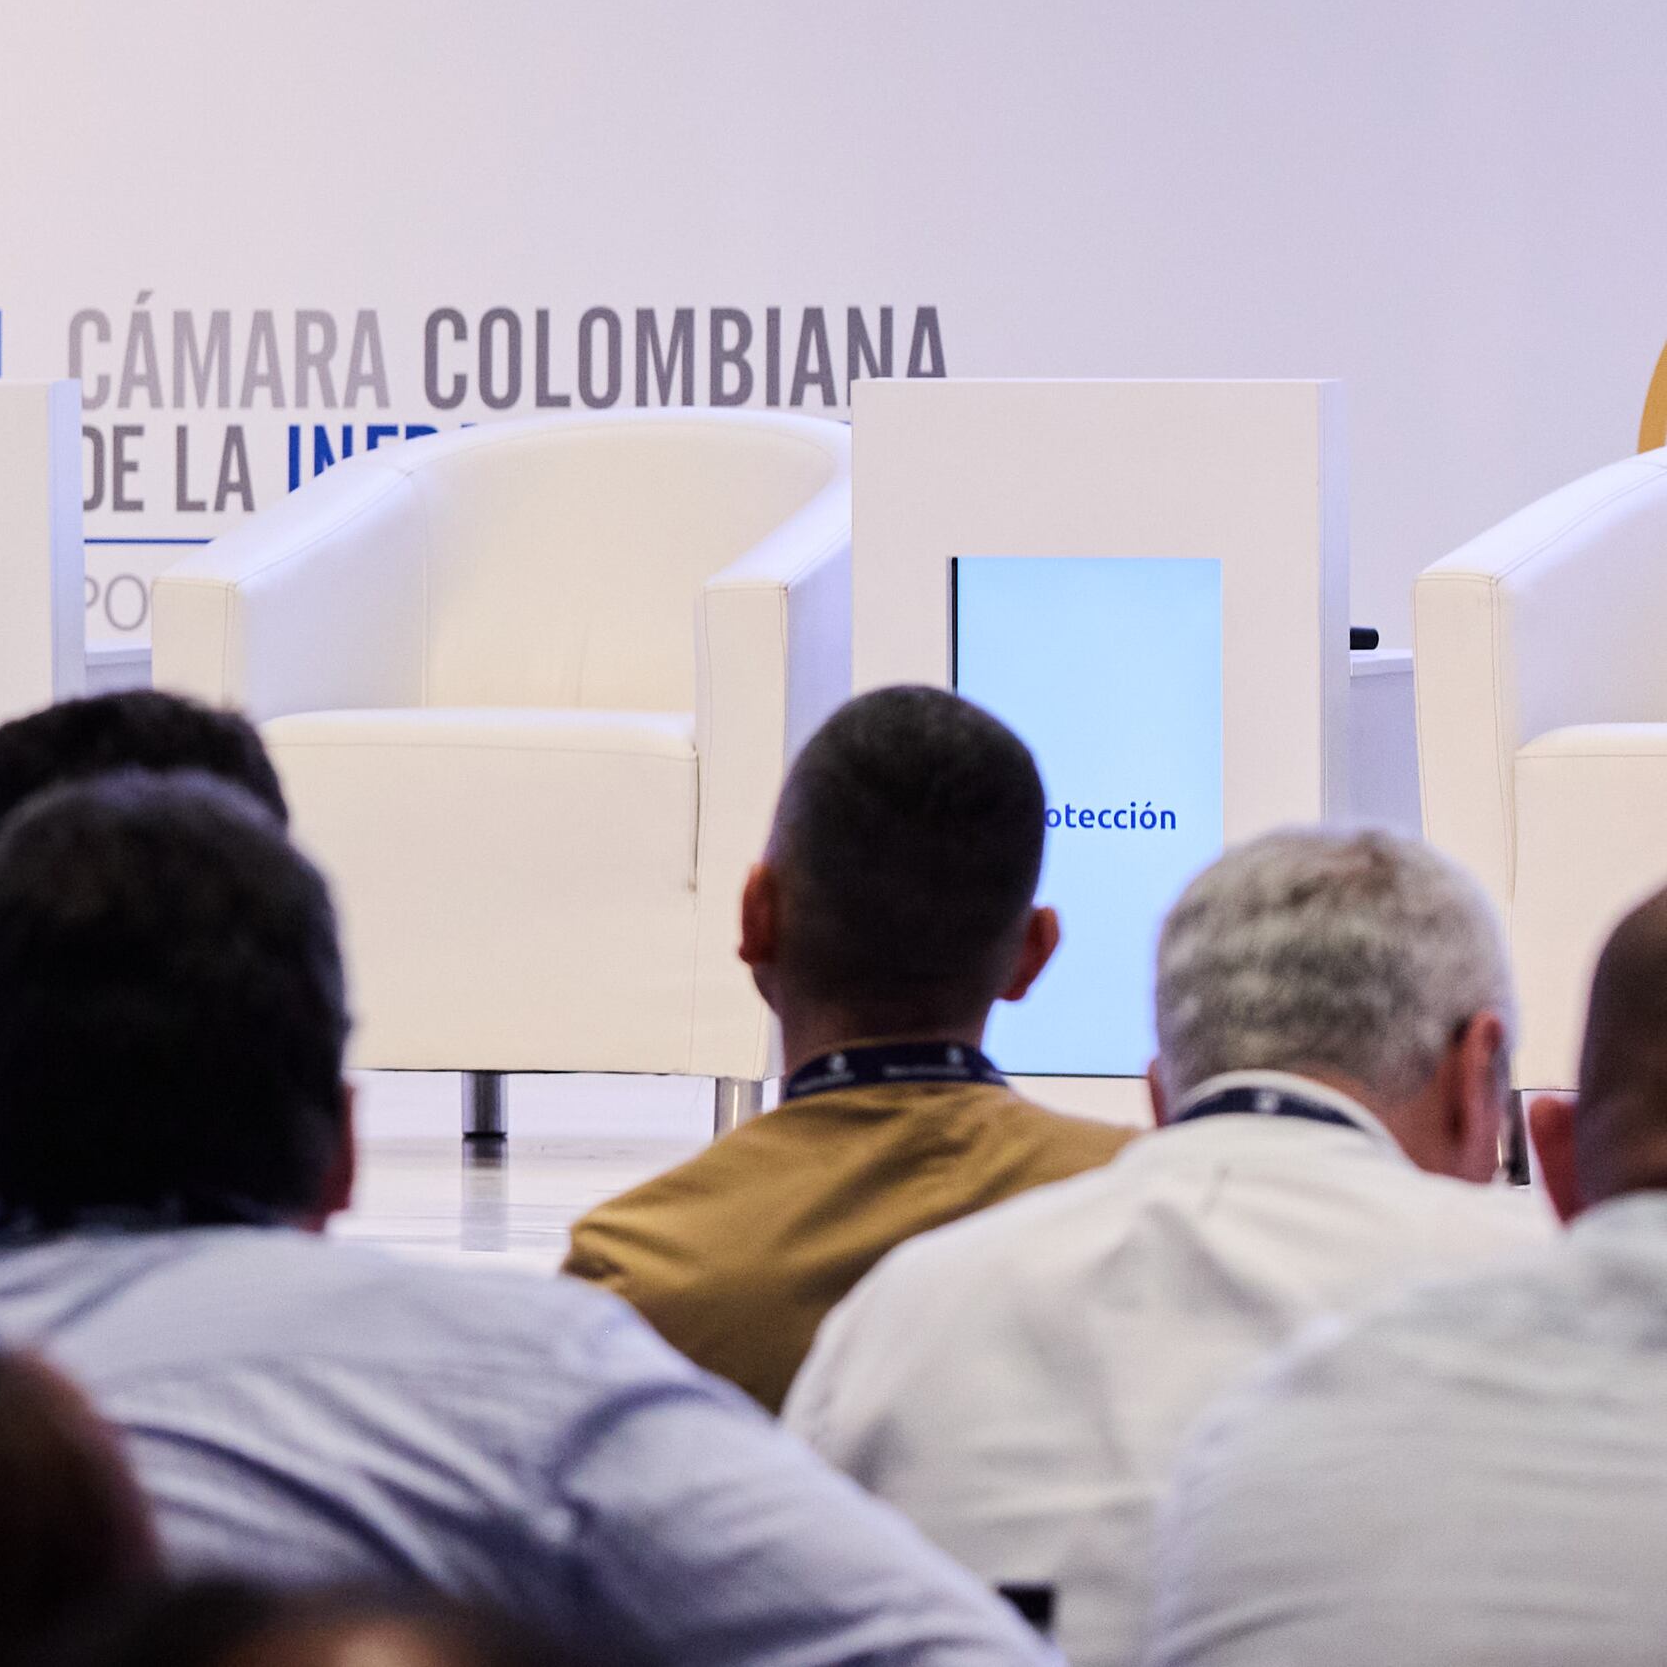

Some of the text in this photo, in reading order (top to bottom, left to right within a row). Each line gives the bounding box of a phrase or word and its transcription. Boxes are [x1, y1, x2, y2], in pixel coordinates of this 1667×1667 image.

[68, 290, 948, 410] CÁMARA COLOMBIANA
[175, 424, 256, 513] LA
